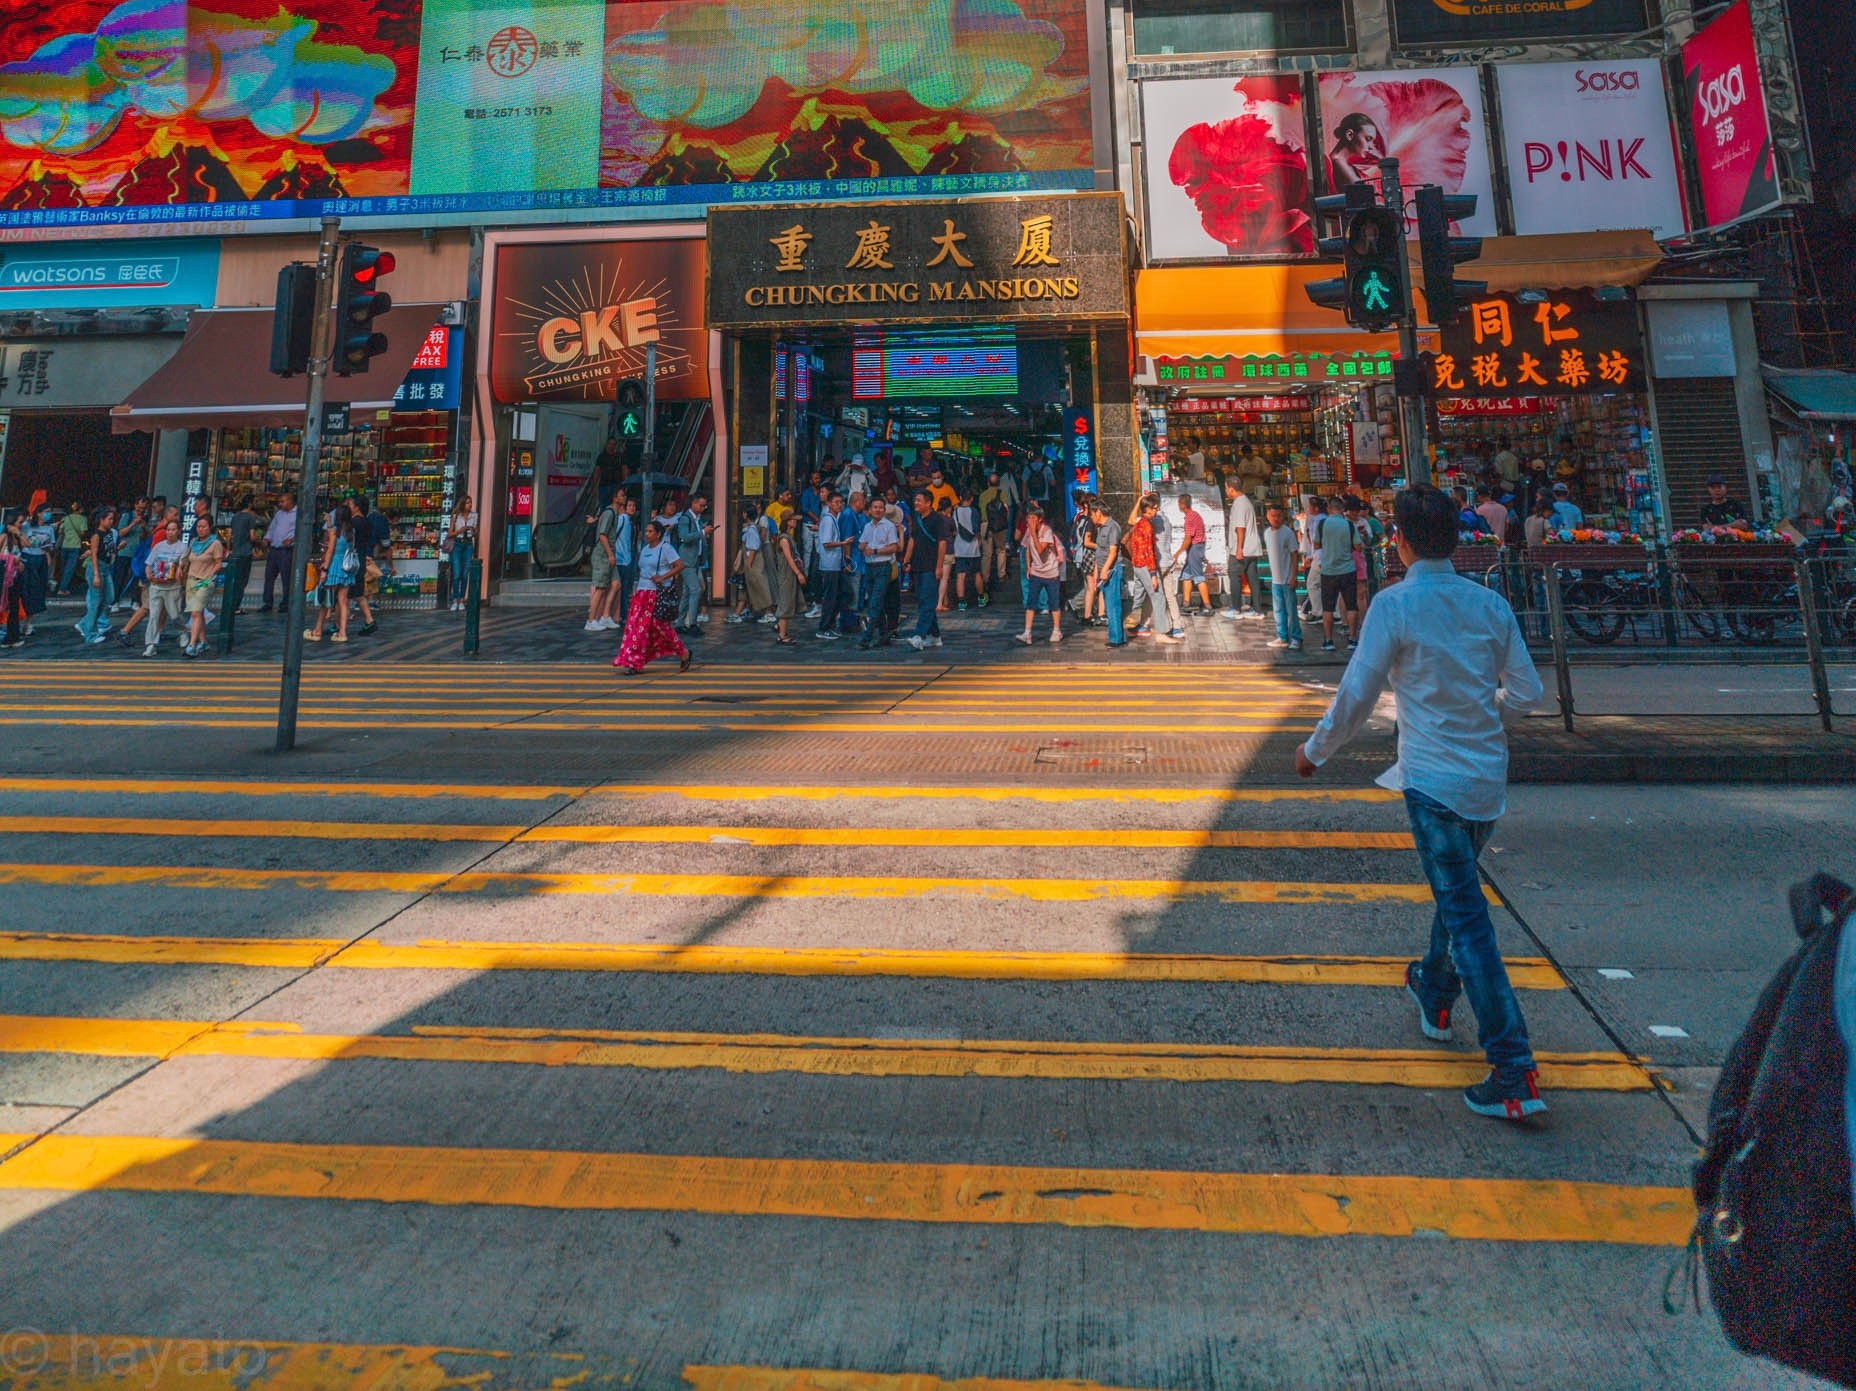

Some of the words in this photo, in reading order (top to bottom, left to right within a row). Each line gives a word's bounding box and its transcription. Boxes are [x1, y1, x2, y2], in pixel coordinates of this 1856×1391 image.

[1505, 3, 1521, 14] DE
[1522, 1, 1565, 12] CORAL
[1524, 138, 1652, 183] P!NK
[13, 267, 106, 283] watsons
[118, 264, 164, 280] 屈臣氏
[744, 282, 920, 307] CHUNGKING
[928, 277, 1079, 302] MANSIONS
[537, 297, 660, 364] CKE
[1471, 300, 1579, 347] 同仁
[417, 346, 442, 356] AX
[538, 366, 611, 389] CHUNGKING
[1326, 360, 1392, 376] 全國包郵
